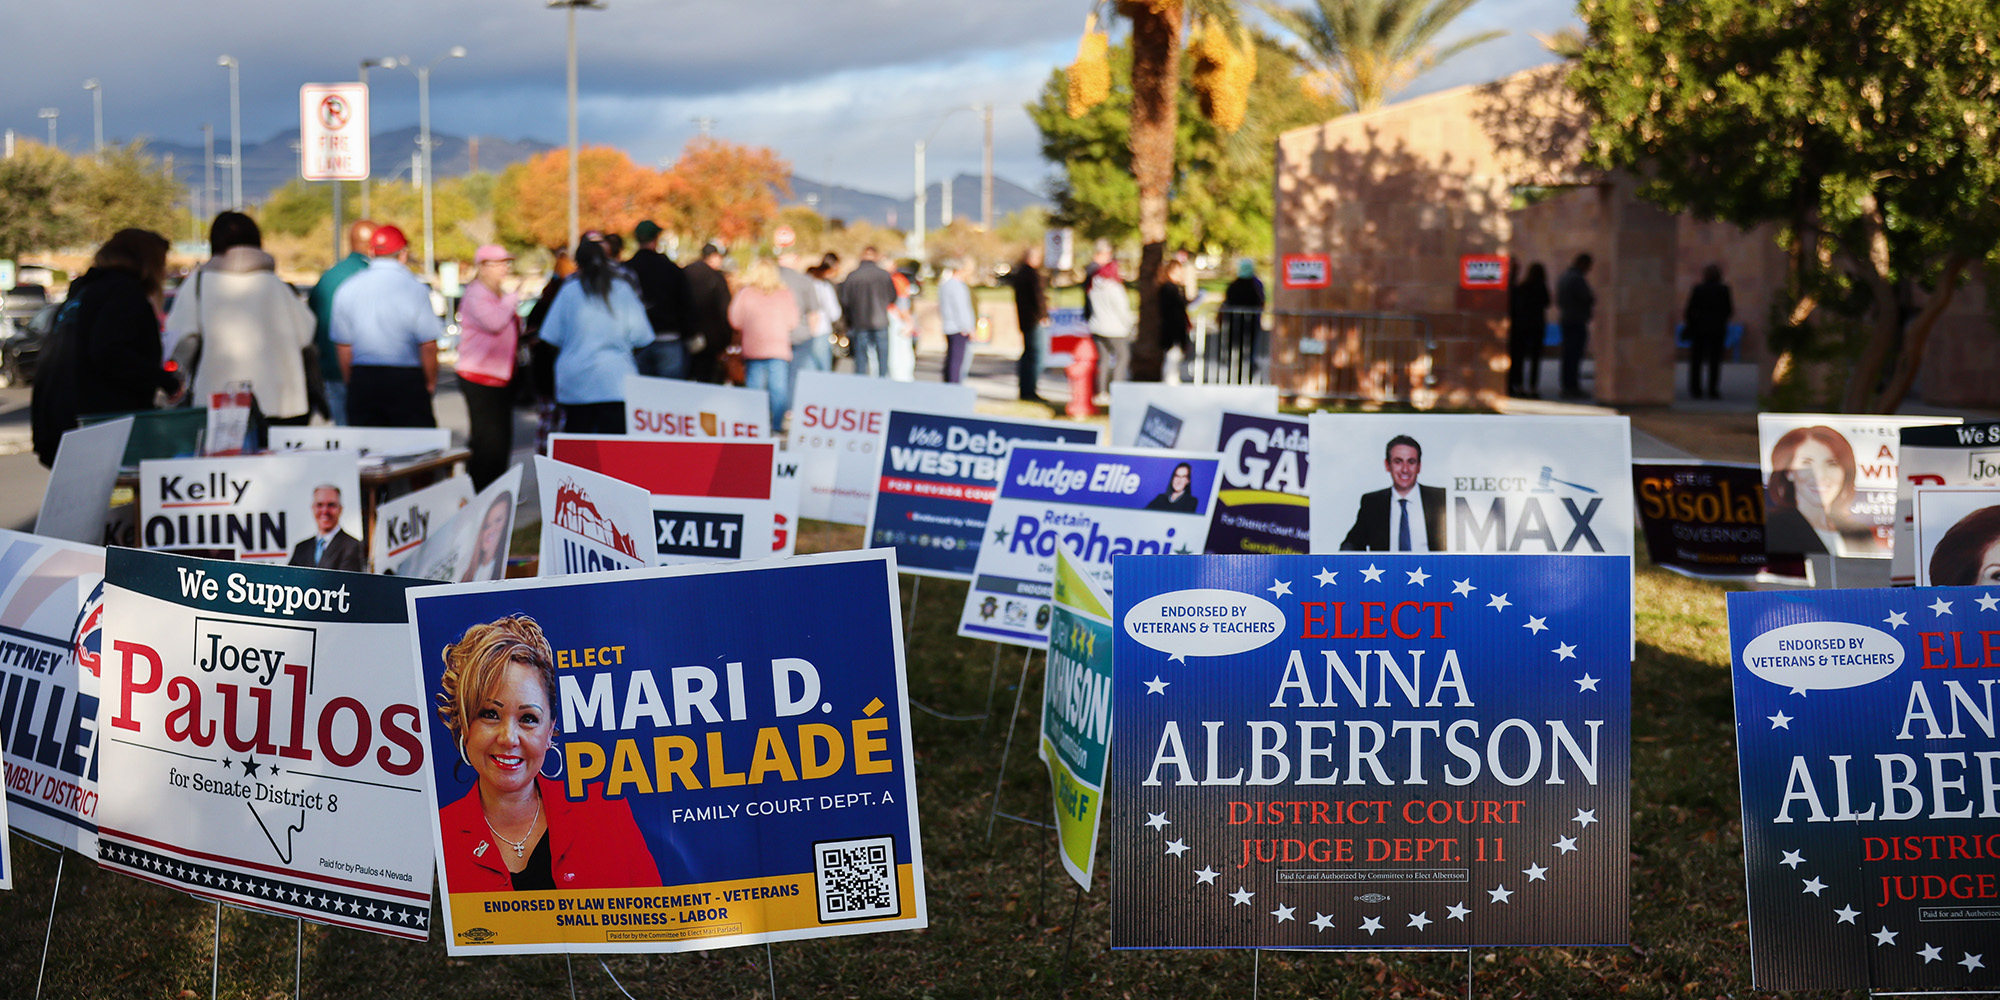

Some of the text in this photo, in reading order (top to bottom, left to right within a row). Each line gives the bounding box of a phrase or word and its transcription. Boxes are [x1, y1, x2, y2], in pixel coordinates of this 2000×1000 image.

[634, 409, 695, 437] SUSIE
[803, 405, 882, 434] SUSIE
[797, 435, 873, 453] FOR CO
[908, 425, 944, 448] Vote
[1956, 427, 1985, 444] We
[890, 446, 1004, 482] WESTB
[1016, 459, 1141, 495] Judge Ellie
[1223, 427, 1309, 497] GA
[1973, 460, 2000, 480] Jo
[161, 472, 250, 504] Kelly
[887, 479, 912, 492] FOR
[913, 483, 962, 498] NEVADA
[1454, 477, 1527, 492] ELECT
[1674, 472, 1713, 487] STEVE
[145, 512, 287, 550] QUINN
[387, 505, 430, 549] Kelly
[1043, 510, 1091, 527] Retain
[1454, 497, 1605, 552] MAX
[1672, 523, 1763, 543] GOVERNOR
[657, 519, 738, 549] XALT
[177, 567, 350, 616] We Support
[1161, 606, 1247, 618] ENDORSED BY
[1300, 600, 1454, 640] ELECT
[1132, 622, 1275, 634] VETERANS & TEACHERS
[200, 633, 285, 686] Joey
[557, 645, 626, 669] ELECT
[1778, 638, 1865, 651] ENDORSED BY
[1918, 630, 2000, 670] ELE
[1752, 653, 1895, 668] VETERANS & TEACHERS
[1270, 649, 1475, 708] ANNA
[111, 639, 424, 776] Paulos
[558, 657, 833, 734] MARI D.
[1896, 679, 2000, 740] AN
[0, 671, 99, 784] ILLE
[564, 697, 893, 798] PARLADÉ
[1141, 718, 1604, 787] ALBERTSON
[42, 776, 99, 818] DISTRICT
[169, 768, 338, 812] for Senate District 8
[672, 790, 895, 824] FAMILY COURT DEPT. A
[1078, 794, 1089, 822] F
[1227, 800, 1526, 825] DISTRICT COURT
[1237, 838, 1506, 869] JUDGE DEPT. 11
[319, 857, 413, 882] Paid for by Paulos 4 Nevada
[1280, 871, 1465, 881] Paid for and Authorized by Committee to Elect Albertson
[484, 899, 555, 913] ENDORSED
[558, 898, 574, 910] BY
[577, 898, 605, 910] LAW
[608, 892, 712, 910] ENFORCEMENT
[723, 883, 800, 903] VETERANS
[1877, 874, 1999, 907] JUDGE
[556, 914, 599, 926] SMALL
[602, 912, 668, 926] BUSINESS
[679, 907, 729, 924] LABOR
[1923, 910, 1938, 918] Paid
[1938, 910, 1950, 918] for
[1950, 910, 1964, 918] and
[622, 931, 631, 939] for
[631, 932, 638, 940] by
[638, 931, 648, 939] the
[648, 930, 679, 939] Committee
[687, 929, 702, 937] Elect
[703, 927, 717, 935] Mari
[717, 926, 740, 934] Parlade
